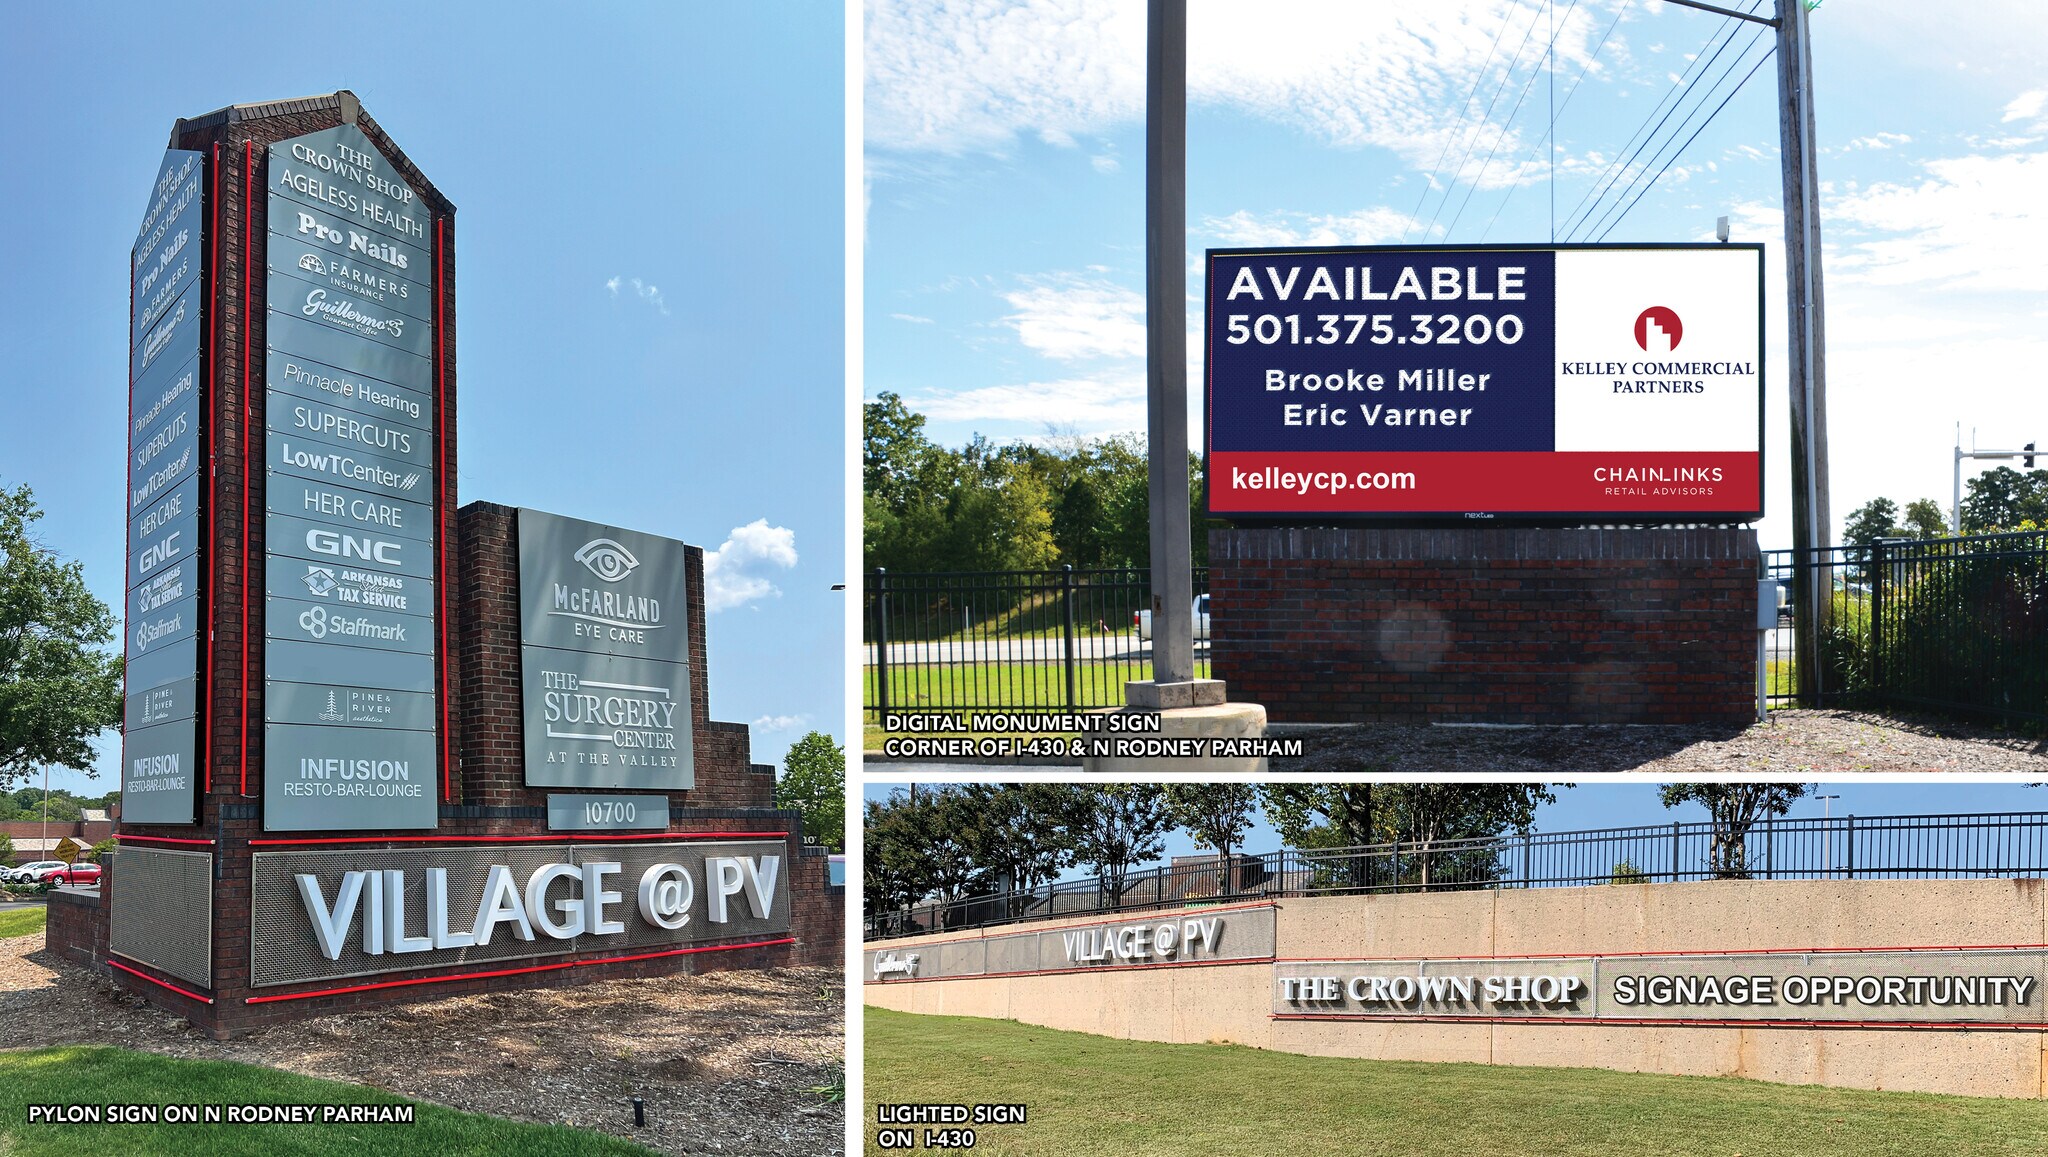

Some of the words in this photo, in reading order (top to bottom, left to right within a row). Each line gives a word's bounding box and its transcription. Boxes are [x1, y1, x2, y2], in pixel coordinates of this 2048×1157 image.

[337, 143, 372, 171] THE
[158, 165, 174, 198] THE
[292, 143, 362, 184] CROWN
[366, 174, 413, 204] SHOP
[140, 189, 169, 237] CROWN
[169, 155, 193, 198] SHOP
[281, 169, 357, 212] AGELESS
[362, 200, 423, 239] HEALTH
[136, 219, 165, 271] AGELESS
[166, 175, 198, 230] HEALTH
[298, 212, 343, 245] Pro
[348, 231, 408, 269] Nails
[141, 266, 159, 298] Pro
[160, 228, 189, 273] Nails
[151, 257, 188, 310] FARMERS
[330, 260, 408, 299] FARMERS
[330, 277, 384, 302] INSURANCE
[1226, 265, 1528, 301] AVAILABLE
[302, 288, 404, 338] Guillermo's
[322, 313, 355, 329] Gourmet
[1225, 312, 1525, 346] 501.375.3200
[1264, 369, 1386, 392] Brooke
[1397, 368, 1491, 392] Miller
[1561, 362, 1628, 375] KELLEY
[1632, 362, 1755, 375] COMMERCIAL
[284, 363, 354, 397] Pinnacle
[358, 383, 420, 419] Hearing
[1612, 380, 1704, 394] PARTNERS
[135, 401, 161, 436] Pinnacle
[161, 372, 192, 410] Hearing
[1283, 403, 1348, 427] Eric
[1360, 403, 1473, 427] Varner
[137, 412, 187, 471] SUPERCUTS
[294, 406, 412, 454] SUPERCUTS
[1231, 466, 1417, 496] kelleycp.com
[1605, 487, 1647, 496] RETAIL
[1653, 487, 1714, 496] ADVISORS
[139, 511, 157, 539] HER
[157, 493, 182, 526] CARE
[304, 489, 345, 518] HER
[351, 500, 403, 528] CARE
[139, 531, 180, 574] GNC
[305, 529, 402, 566] GNC
[341, 570, 403, 589] ARKANSAS
[151, 593, 161, 610] TAX
[161, 582, 183, 605] SERVICE
[337, 587, 360, 603] TAX
[362, 591, 407, 610] SERVICE
[553, 582, 661, 624] McFARLAND
[147, 613, 182, 643] Staffmark
[330, 615, 406, 642] Staffmark
[574, 623, 601, 639] EYE
[609, 627, 644, 645] CARE
[154, 689, 169, 700] PINE
[541, 670, 578, 691] THE
[154, 700, 173, 710] RIVER
[352, 692, 383, 702] PINE
[385, 695, 391, 703] &
[352, 704, 391, 714] RIVER
[544, 692, 677, 730] SURGERY
[612, 729, 676, 750] CENTER
[133, 753, 180, 778] INFUSION
[301, 758, 409, 781] INFUSION
[546, 751, 567, 763] AT
[577, 752, 609, 765] THE
[619, 754, 678, 767] VALLEY
[127, 776, 186, 793] RESTO-BAR-LOUNGE
[284, 782, 422, 797] RESTO-BAR-LOUNGE
[585, 801, 637, 825] 10700
[294, 861, 626, 961] VILLAGE
[637, 863, 694, 931] @
[705, 855, 780, 924] PV
[1062, 924, 1148, 962] VILLAGE
[1153, 924, 1178, 956] @
[1184, 917, 1223, 954] PV
[1278, 977, 1341, 1002] THE
[1347, 976, 1475, 1003] CROWN
[1483, 976, 1583, 1005] SHOP
